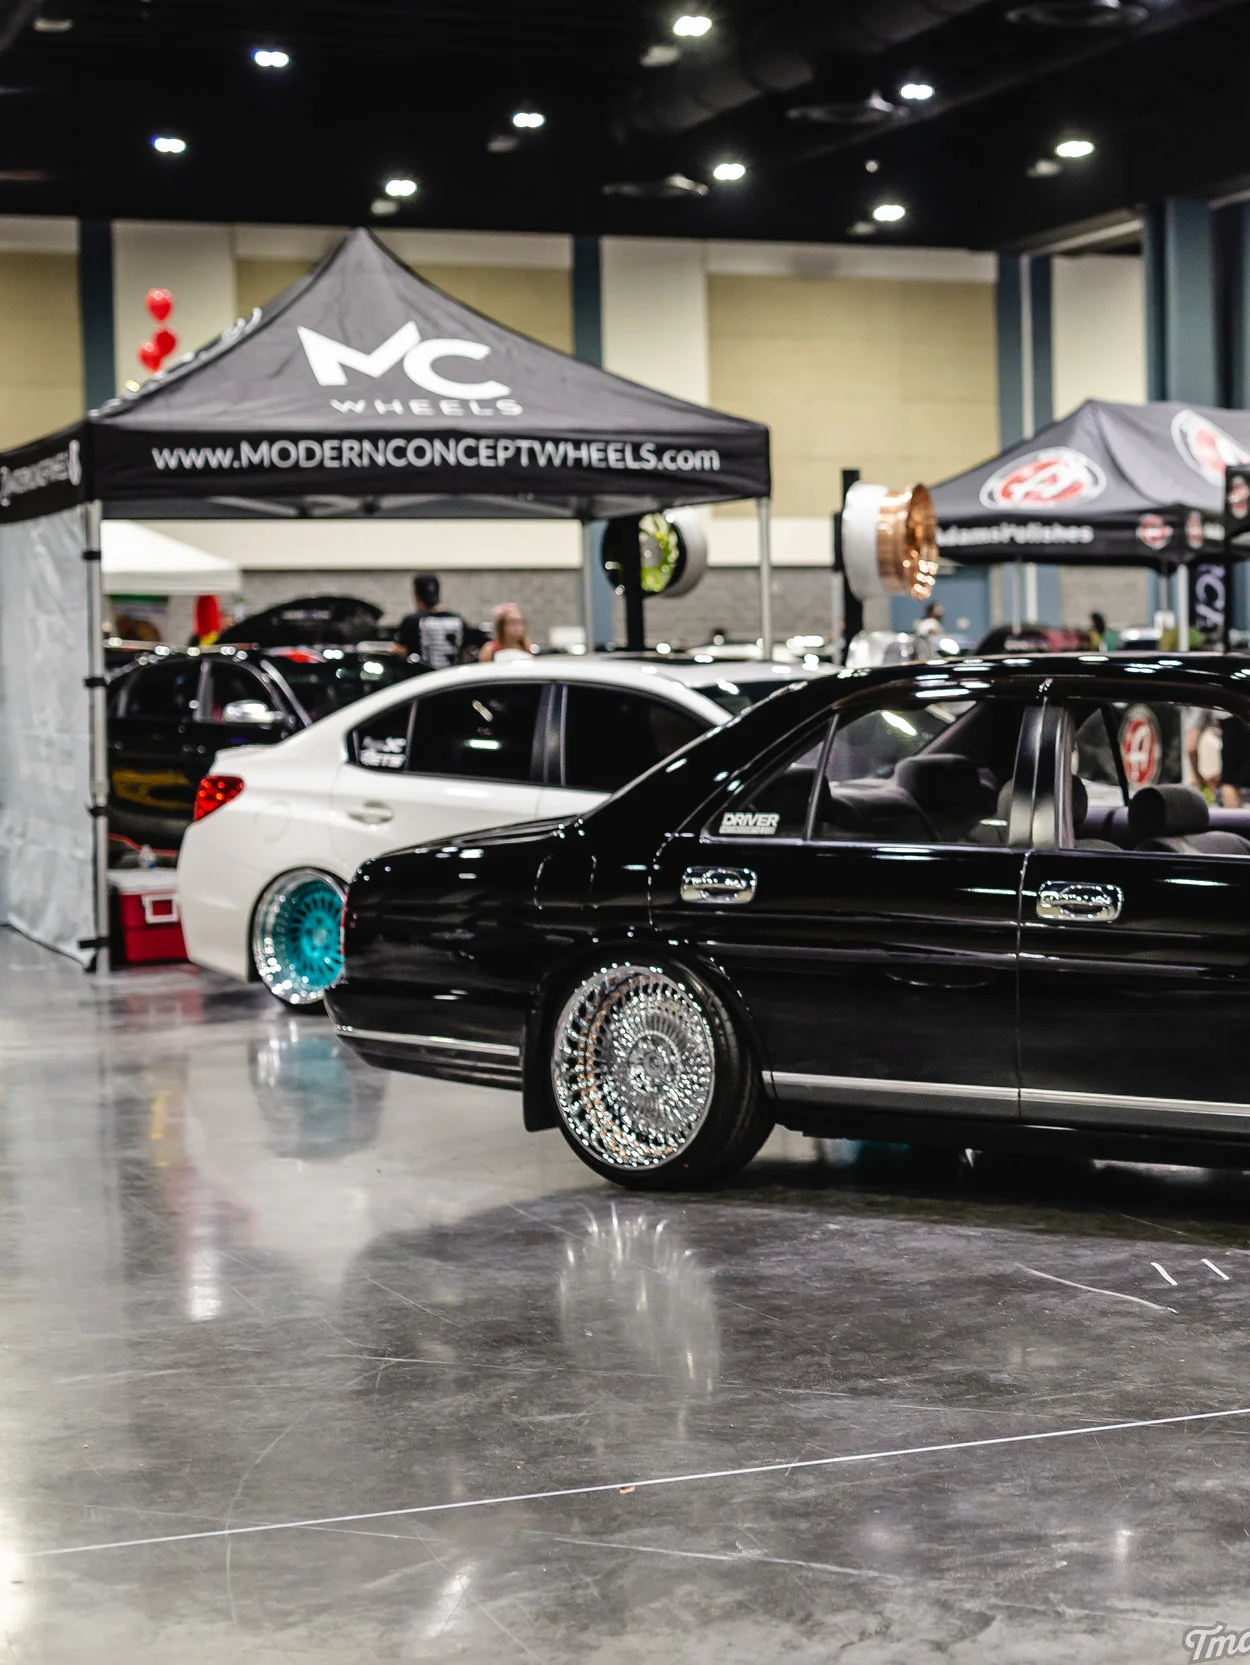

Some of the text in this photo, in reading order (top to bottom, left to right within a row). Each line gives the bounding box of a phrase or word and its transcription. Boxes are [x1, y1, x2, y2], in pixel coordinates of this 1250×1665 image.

[296, 320, 512, 400] MC
[329, 399, 524, 416] WHEELS
[151, 437, 721, 470] www.MODERNCONCEPTWHEELS.com
[721, 811, 780, 827] DRIVER
